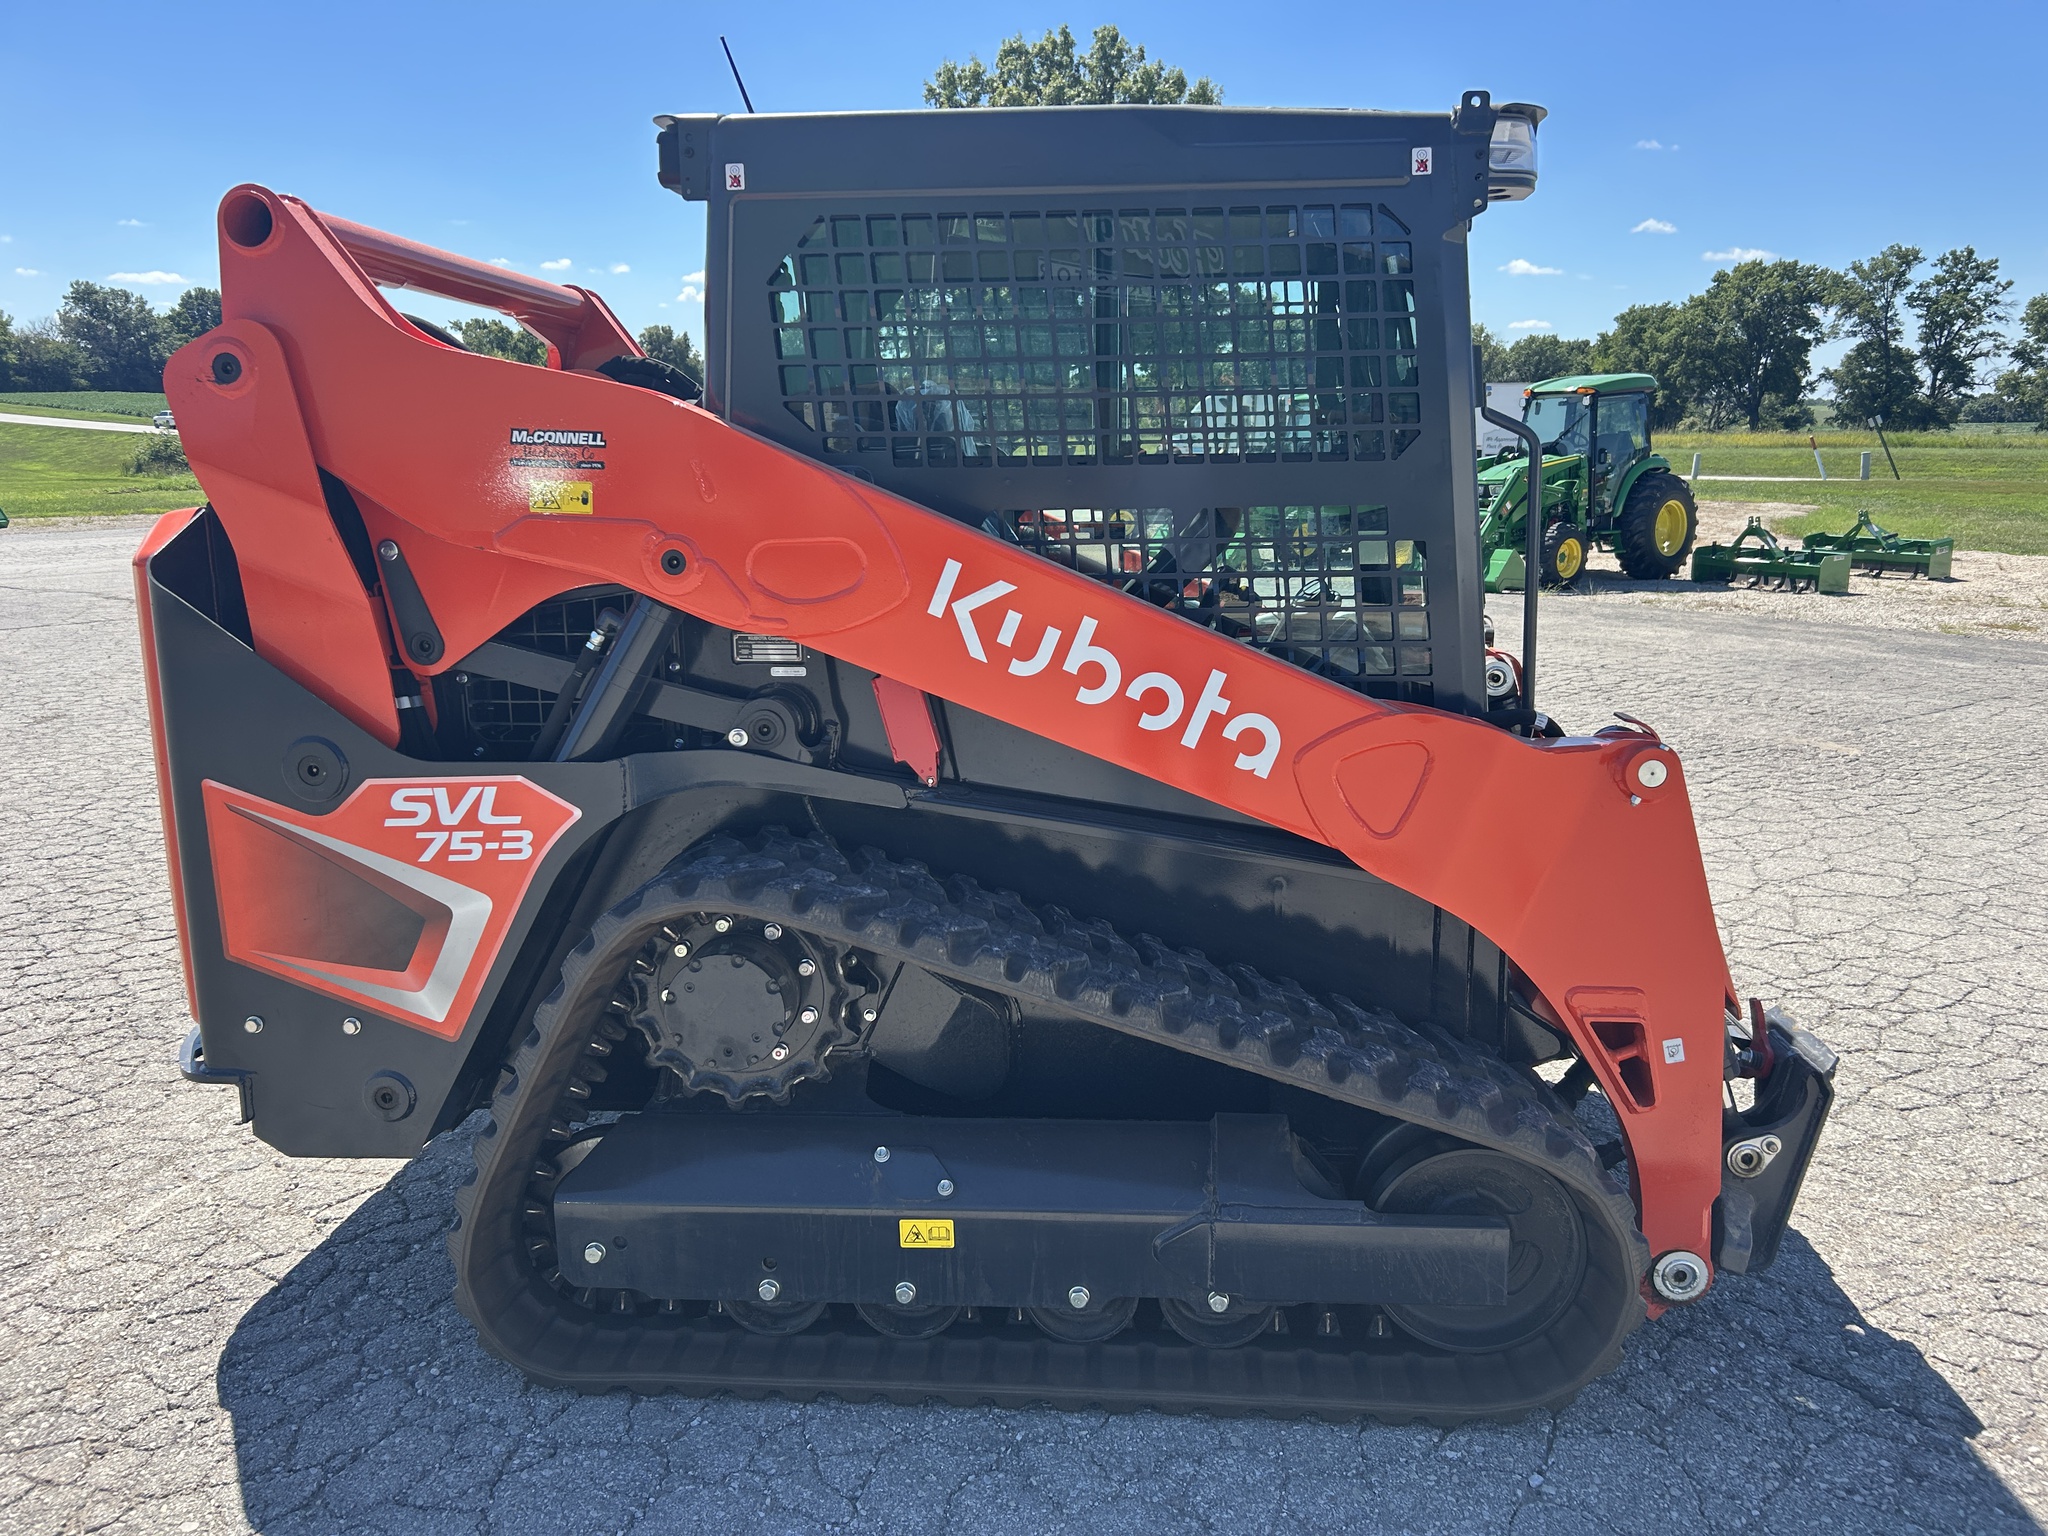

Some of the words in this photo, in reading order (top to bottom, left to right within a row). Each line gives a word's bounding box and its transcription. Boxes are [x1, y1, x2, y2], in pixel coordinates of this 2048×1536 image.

[511, 430, 605, 446] McCONNELL
[928, 559, 1281, 780] Kubota
[384, 787, 522, 827] SVL
[416, 830, 534, 862] 75-3
